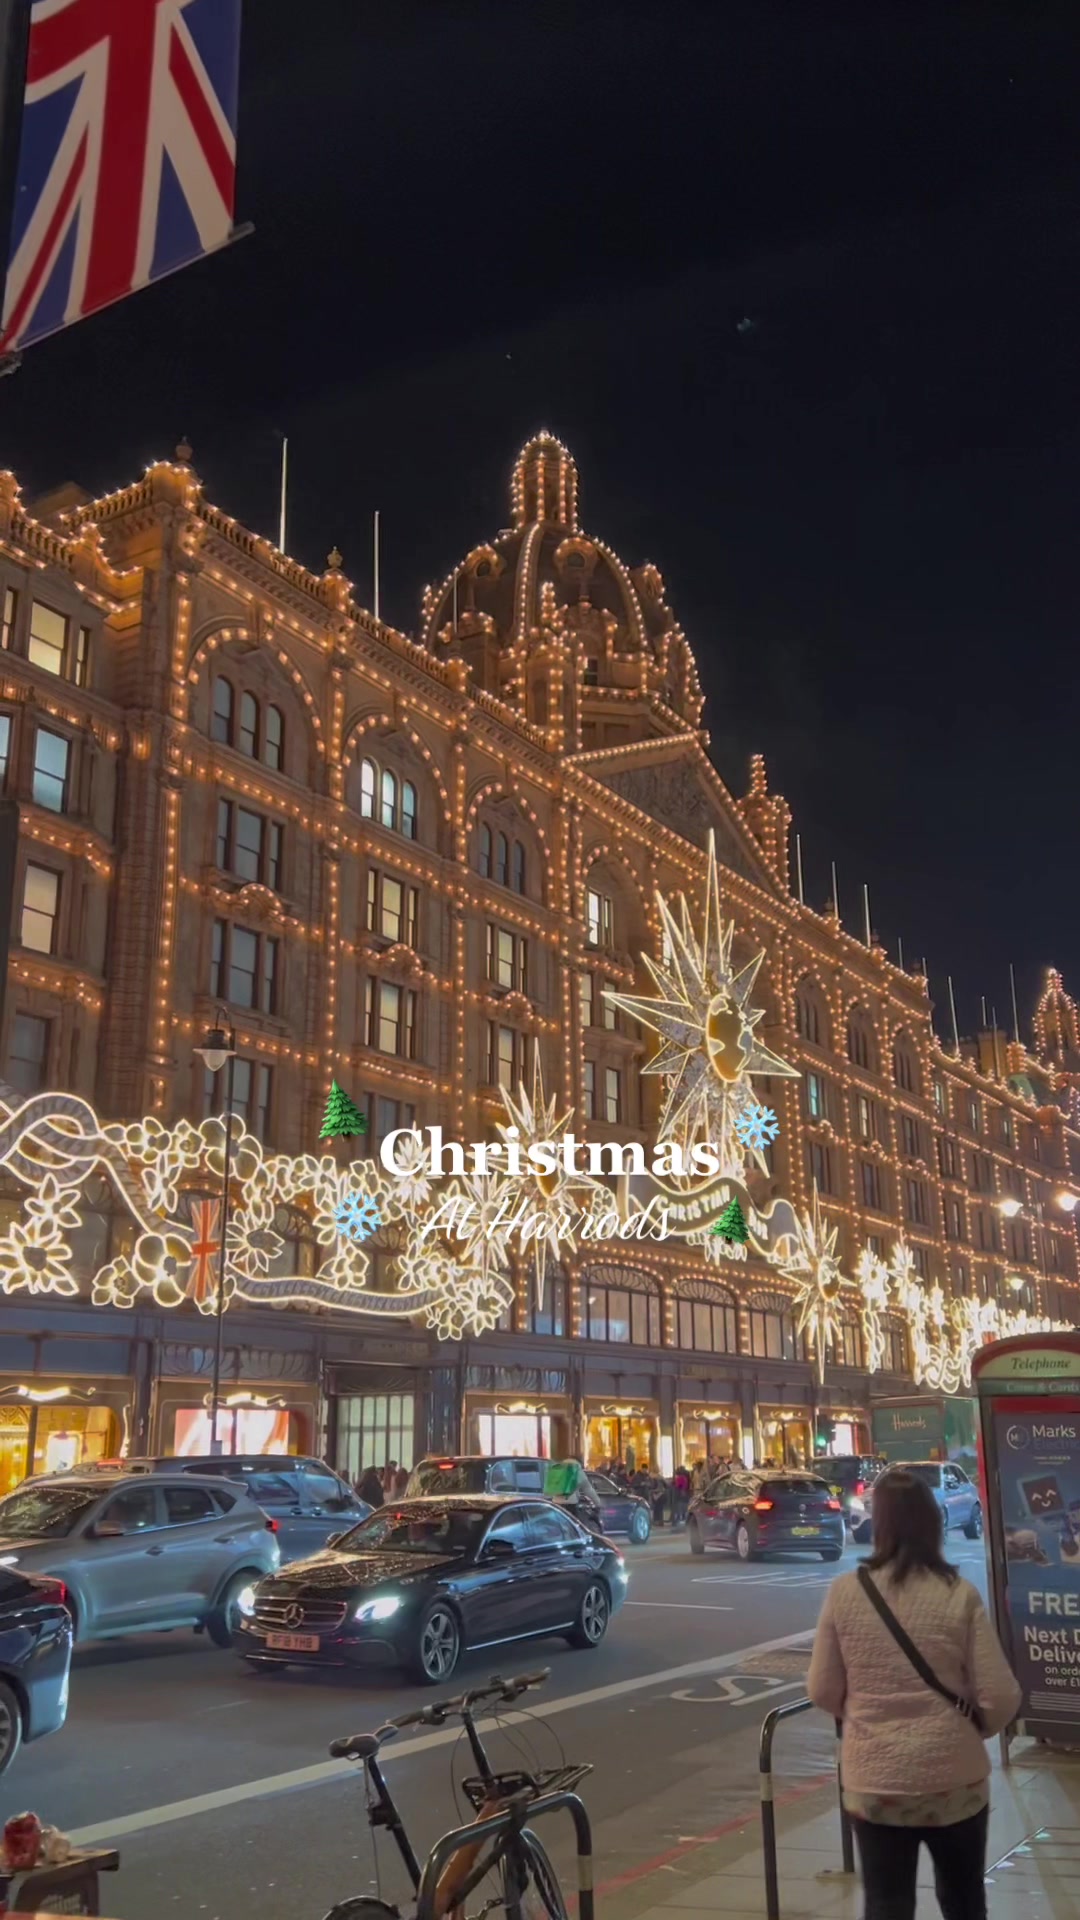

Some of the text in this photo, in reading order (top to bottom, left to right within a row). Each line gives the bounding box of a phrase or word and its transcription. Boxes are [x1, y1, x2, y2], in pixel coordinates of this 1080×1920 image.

[1011, 1356, 1071, 1371] Telephone
[1032, 1425, 1077, 1438] Marks
[1024, 1625, 1068, 1644] Next
[1045, 1666, 1058, 1675] on
[1045, 1677, 1068, 1686] over
